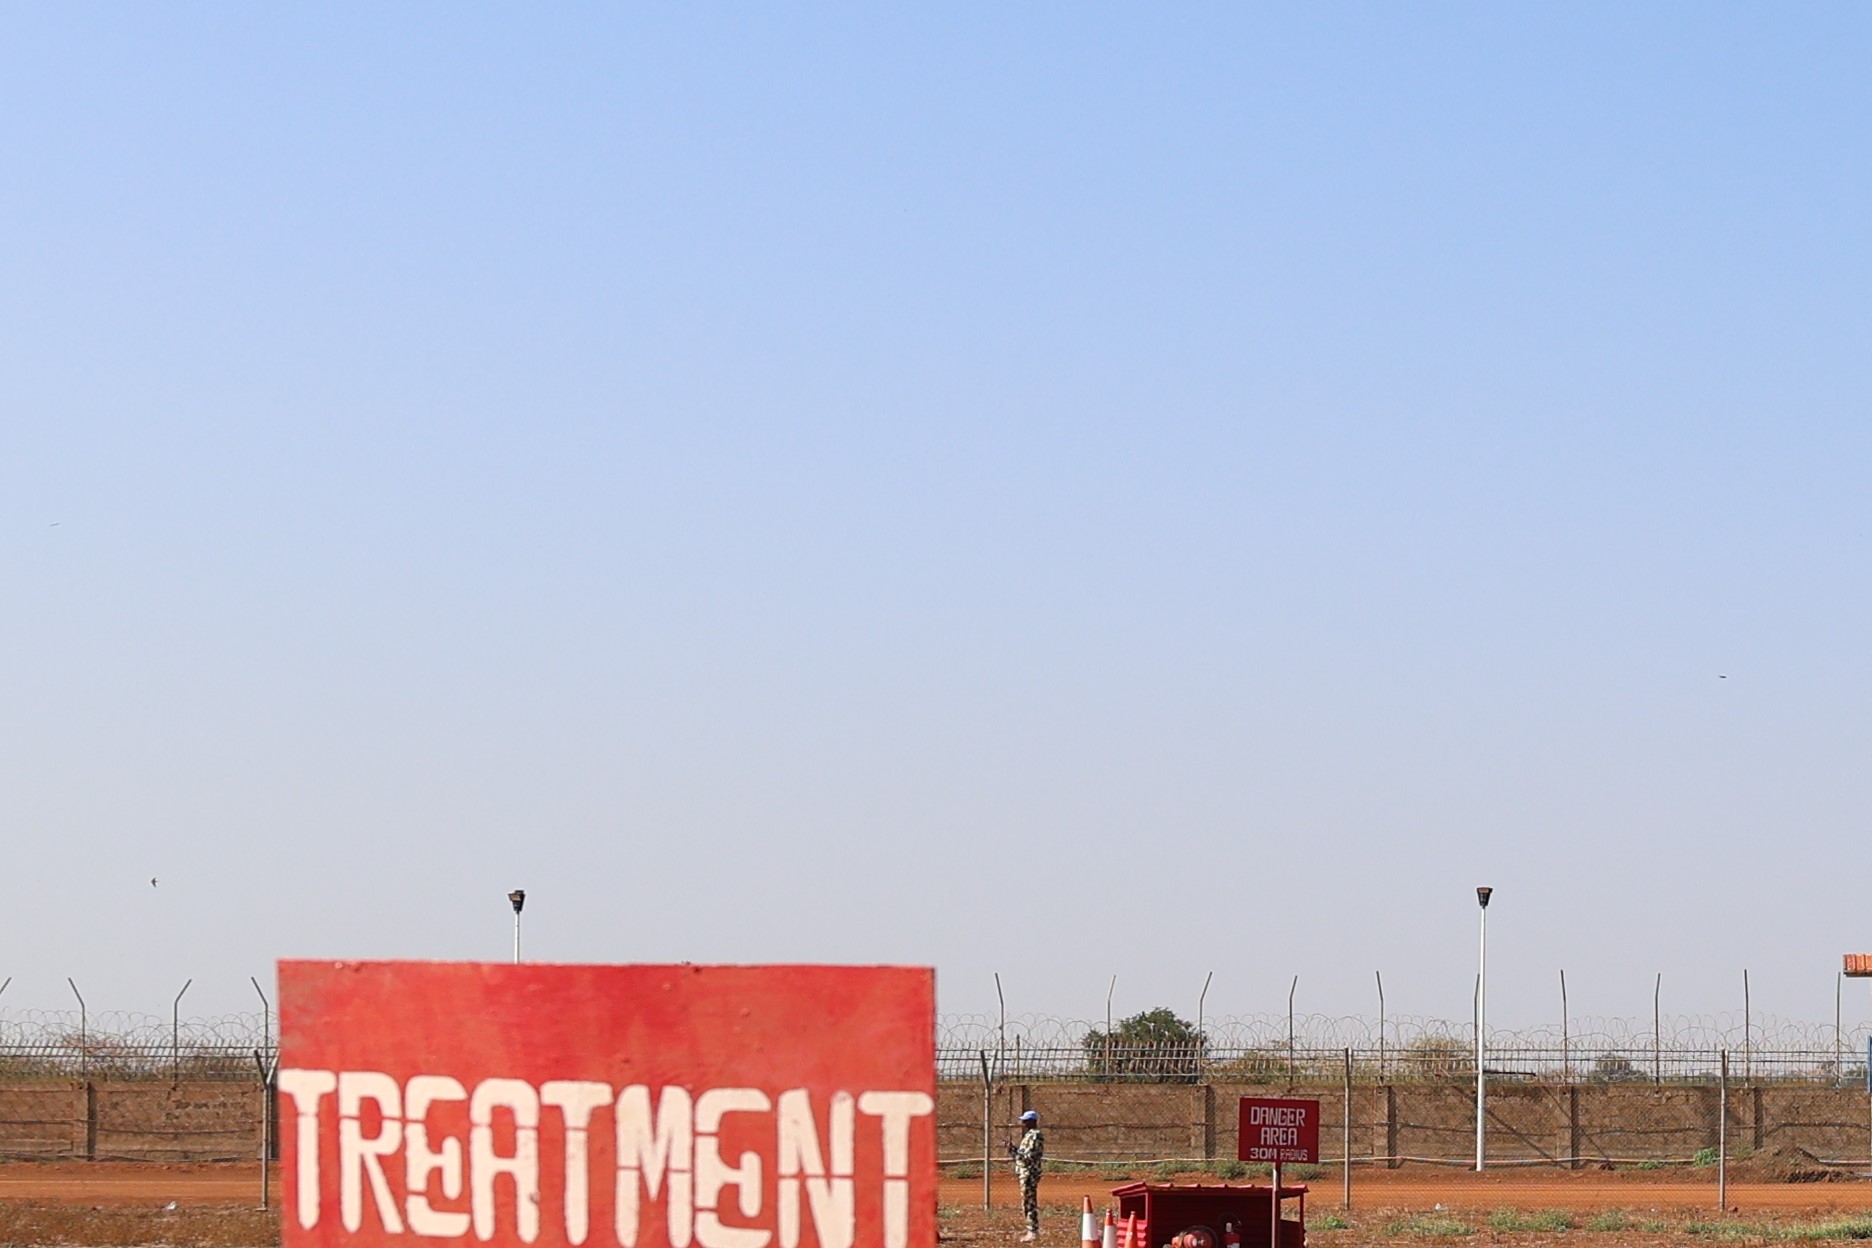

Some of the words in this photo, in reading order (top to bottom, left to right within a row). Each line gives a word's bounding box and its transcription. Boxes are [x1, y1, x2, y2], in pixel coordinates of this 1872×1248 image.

[1250, 1107, 1305, 1126] DANGER
[1260, 1127, 1297, 1145] AREA
[1250, 1148, 1277, 1159] 30M
[1280, 1148, 1308, 1160] RADIUS
